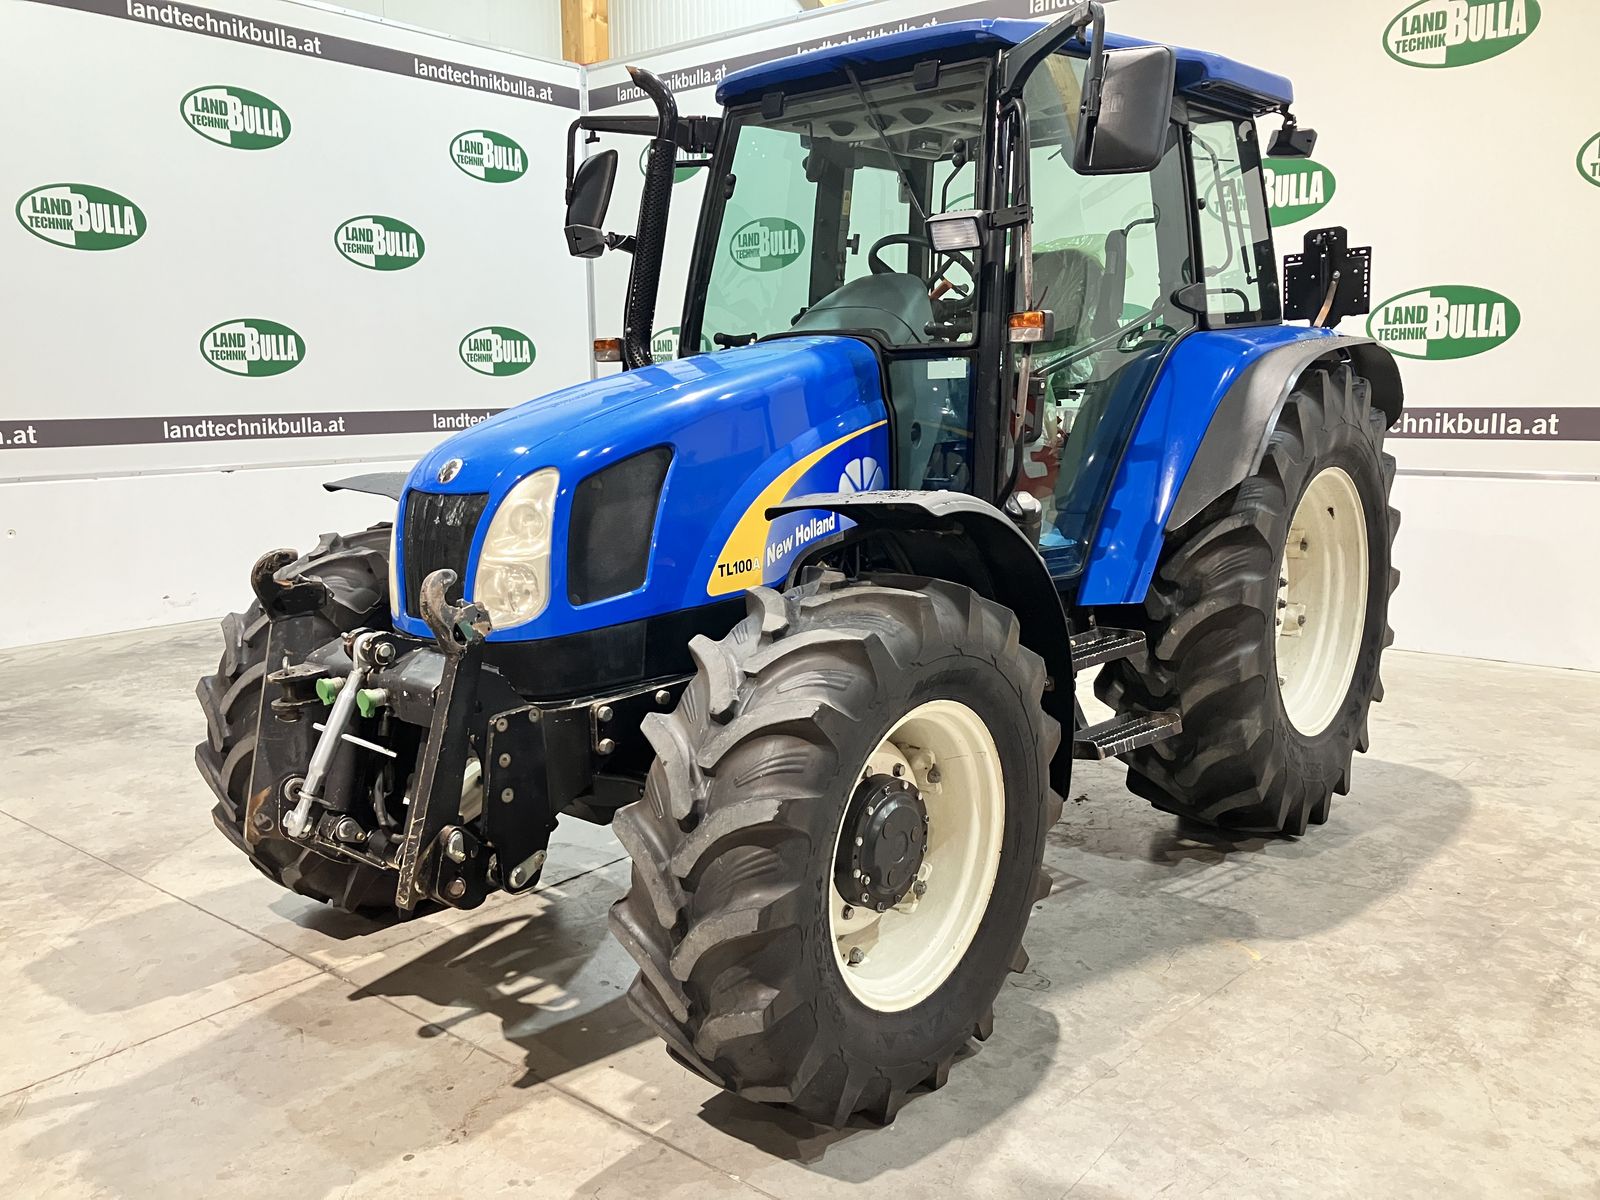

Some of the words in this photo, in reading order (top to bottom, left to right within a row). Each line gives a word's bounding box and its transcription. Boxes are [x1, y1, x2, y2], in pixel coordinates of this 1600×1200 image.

[126, 0, 322, 55] landtechnikbulla.at
[1402, 10, 1448, 36] LAND
[1447, 0, 1527, 47] BULLA
[1394, 33, 1447, 54] TECHNIK
[414, 58, 553, 102] landtechnikbulla.at
[193, 96, 229, 117] LAND
[228, 95, 284, 139] BULLA
[190, 113, 230, 131] TECHNIK
[458, 139, 484, 156] LAND
[483, 137, 523, 173] BULLA
[456, 154, 485, 168] TECHNIK
[1263, 168, 1324, 209] BULLA
[31, 196, 73, 216] LAND
[72, 192, 139, 236] BULLA
[27, 215, 75, 231] TECHNIK
[345, 226, 374, 242] LAND
[372, 223, 419, 258] BULLA
[738, 233, 760, 248] LAND
[759, 226, 800, 257] BULLA
[342, 241, 375, 255] TECHNIK
[1383, 305, 1429, 326] LAND
[1428, 296, 1507, 340] BULLA
[212, 332, 246, 349] LAND
[1377, 325, 1428, 341] TECHNIK
[245, 327, 299, 362] BULLA
[468, 338, 493, 352] LAND
[491, 333, 532, 364] BULLA
[653, 339, 673, 352] LAND
[209, 349, 248, 362] TECHNIK
[465, 352, 494, 364] TECHNIK
[163, 417, 346, 440] landtechnikbulla.at
[766, 534, 794, 566] New
[795, 511, 836, 547] Holland
